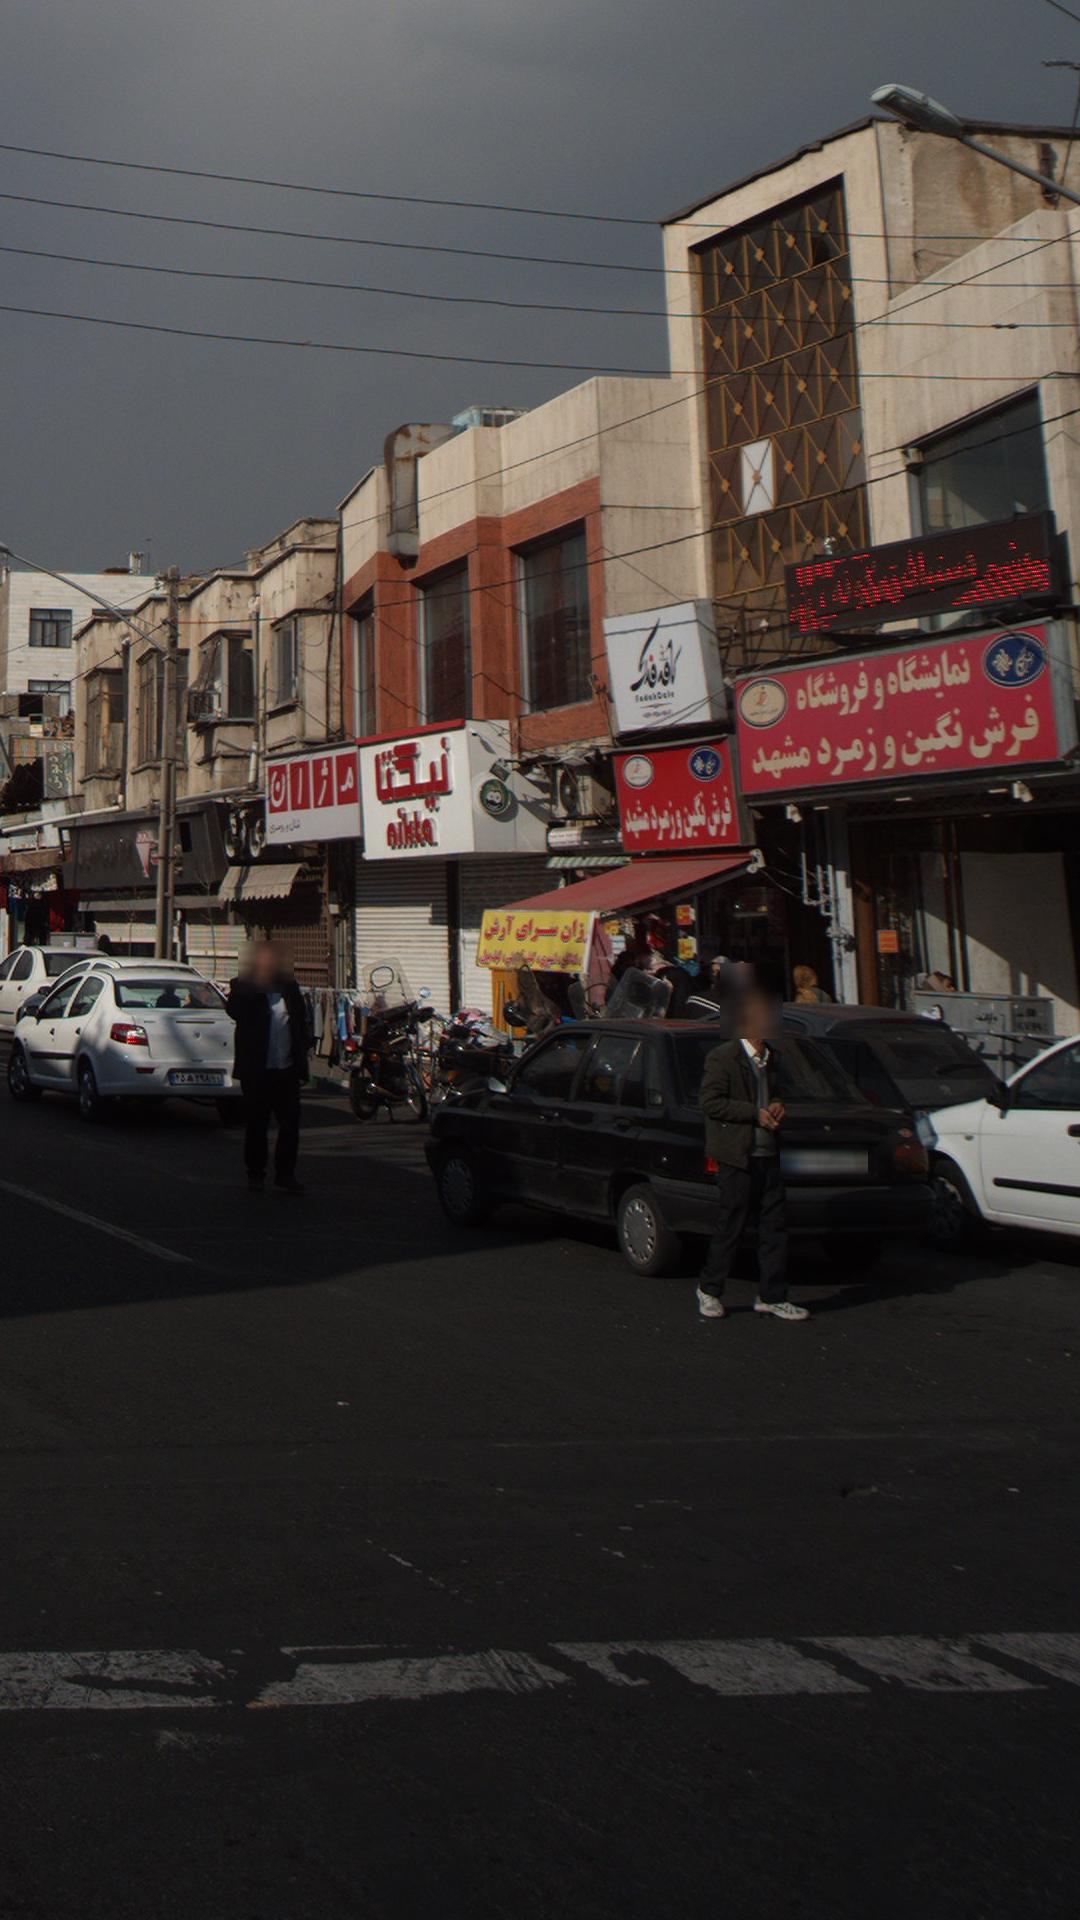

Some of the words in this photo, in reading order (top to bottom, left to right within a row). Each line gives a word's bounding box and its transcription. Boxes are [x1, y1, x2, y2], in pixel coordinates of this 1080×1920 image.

[796, 661, 869, 716] فروشگاه
[873, 677, 885, 710] و
[887, 648, 971, 699] نمایشگاه
[901, 707, 964, 766] نگین
[969, 694, 1040, 759] فرش
[751, 734, 811, 779] مشهد
[816, 727, 877, 776] زمرد
[882, 734, 897, 769] و
[270, 759, 354, 808] مژان
[625, 799, 650, 839] مشهد
[651, 800, 677, 841] زمرد
[676, 807, 684, 839] و
[684, 790, 706, 838] نگین
[707, 785, 733, 837] فرش
[485, 914, 515, 941] آرش
[515, 918, 559, 943] سرای
